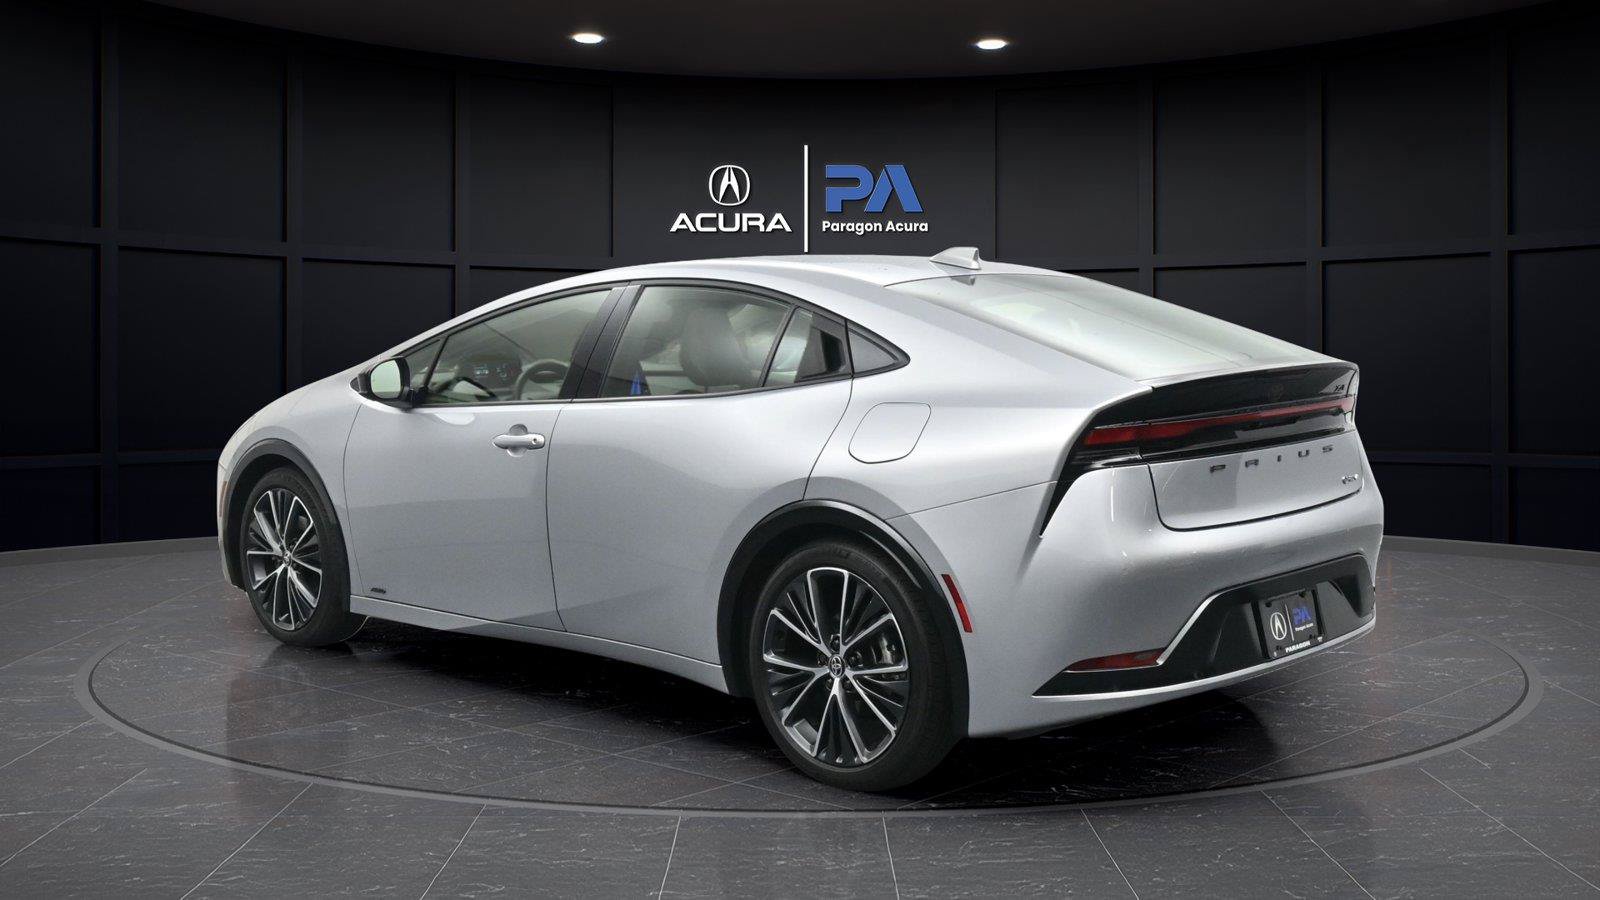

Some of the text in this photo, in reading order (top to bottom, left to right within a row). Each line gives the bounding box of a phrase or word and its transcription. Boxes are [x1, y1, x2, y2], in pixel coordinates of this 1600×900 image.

[825, 164, 923, 213] PA
[670, 212, 792, 233] ACURA
[822, 220, 929, 235] Paragon Acura
[1209, 444, 1334, 473] PRIUS
[1285, 640, 1311, 653] PARAGON
